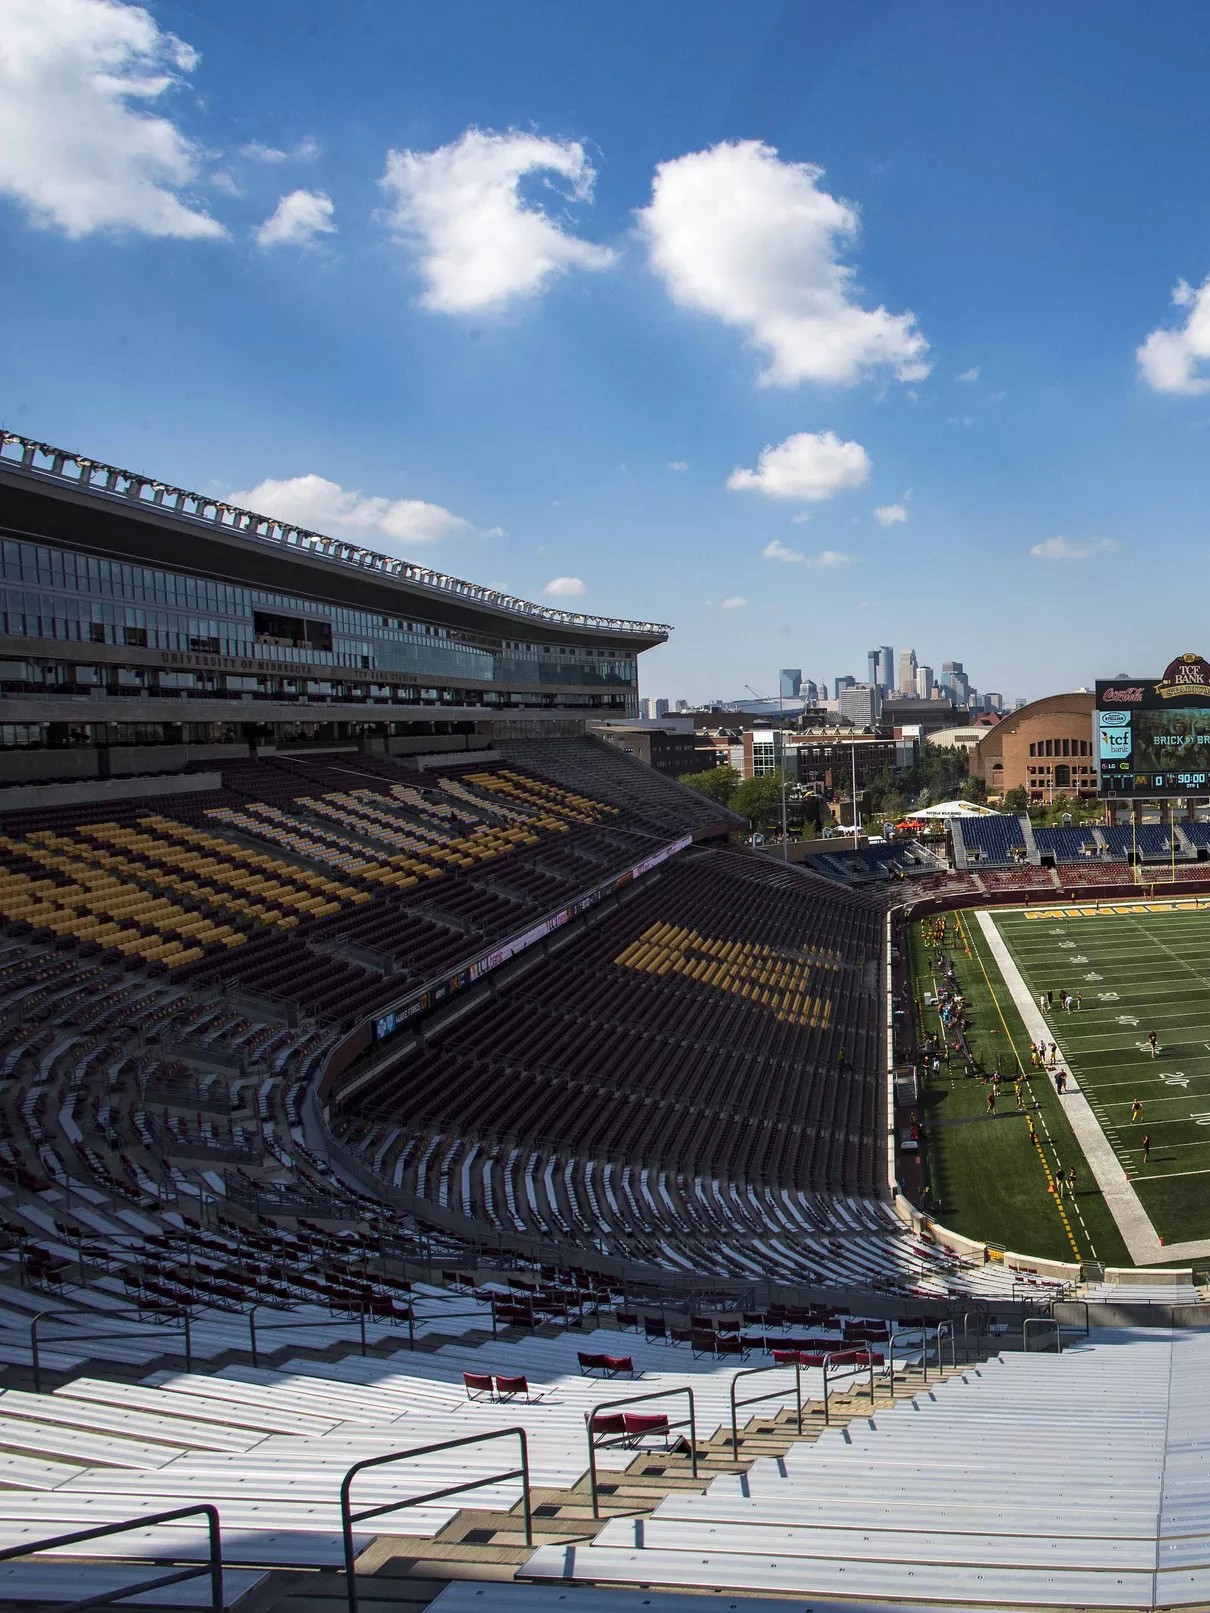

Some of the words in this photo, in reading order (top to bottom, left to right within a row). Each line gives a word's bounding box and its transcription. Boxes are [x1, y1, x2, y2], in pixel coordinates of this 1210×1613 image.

[1179, 665, 1201, 675] TCF
[1175, 674, 1205, 684] BANK
[1109, 731, 1129, 745] tcf
[1153, 736, 1183, 745] BRICK
[1111, 744, 1129, 753] bank
[1155, 776, 1163, 786] 0
[1177, 773, 1206, 783] 90:00
[1159, 1071, 1190, 1086] 20
